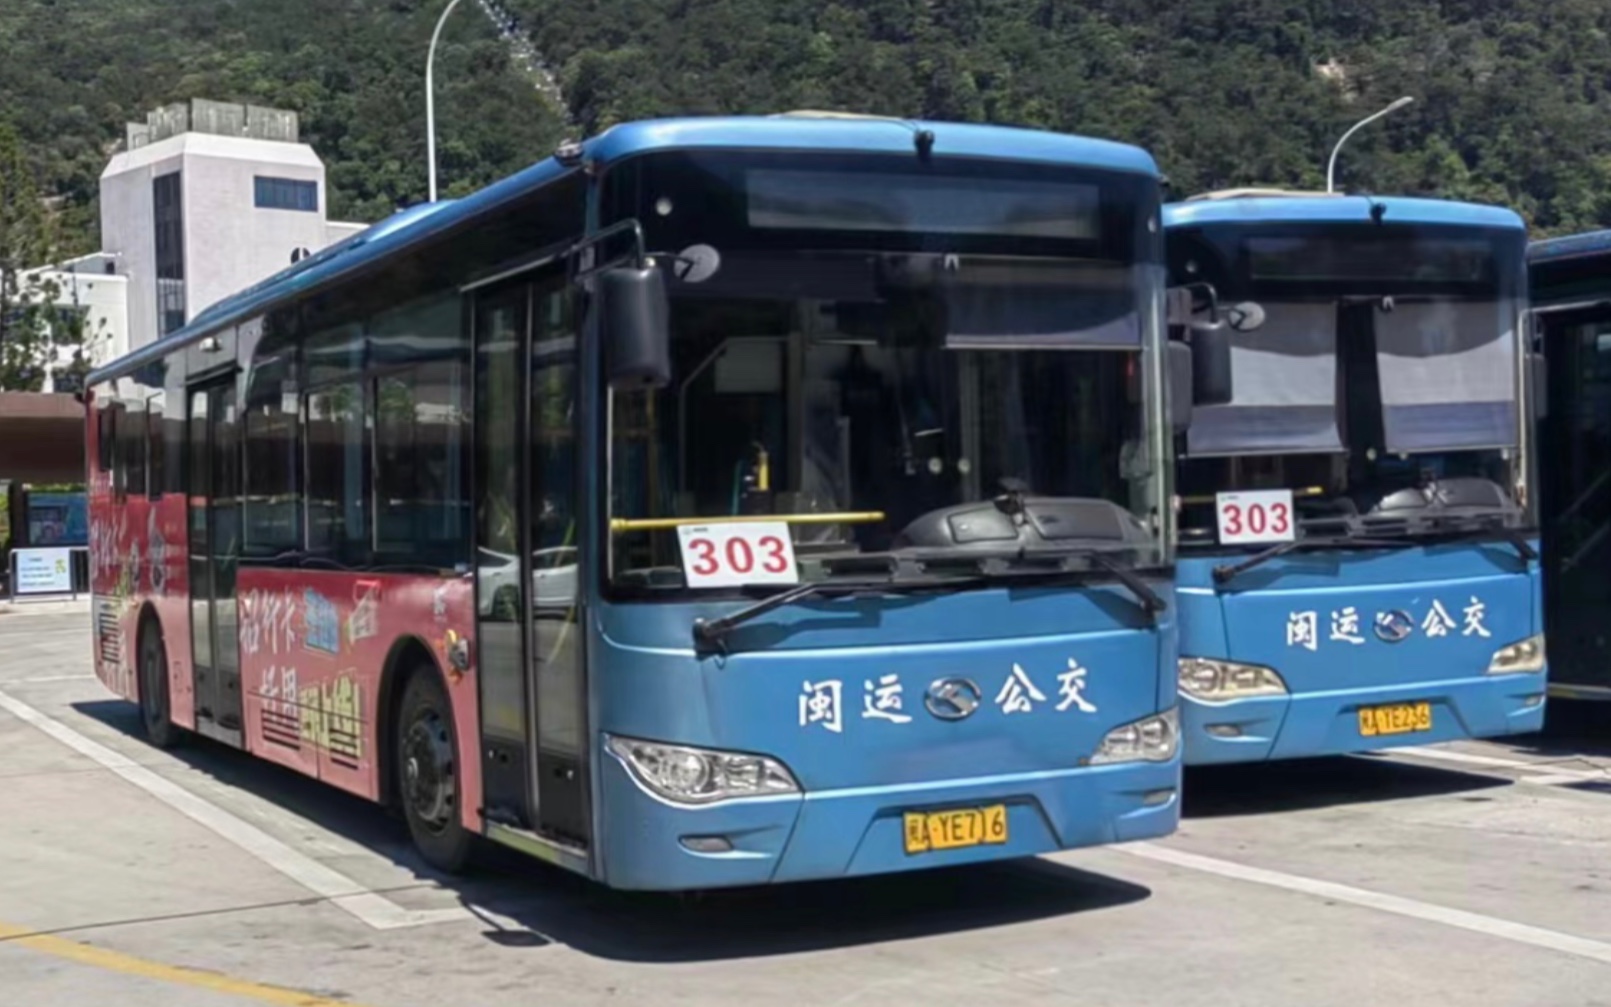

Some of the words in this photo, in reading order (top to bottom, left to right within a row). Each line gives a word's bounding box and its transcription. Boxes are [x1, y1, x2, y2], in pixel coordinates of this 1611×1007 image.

[1222, 502, 1289, 536] 303
[688, 535, 789, 576] 303
[1286, 606, 1366, 651] 闽运
[1420, 595, 1492, 638] 公交
[799, 673, 913, 733] 闽运
[994, 656, 1098, 714] 公交
